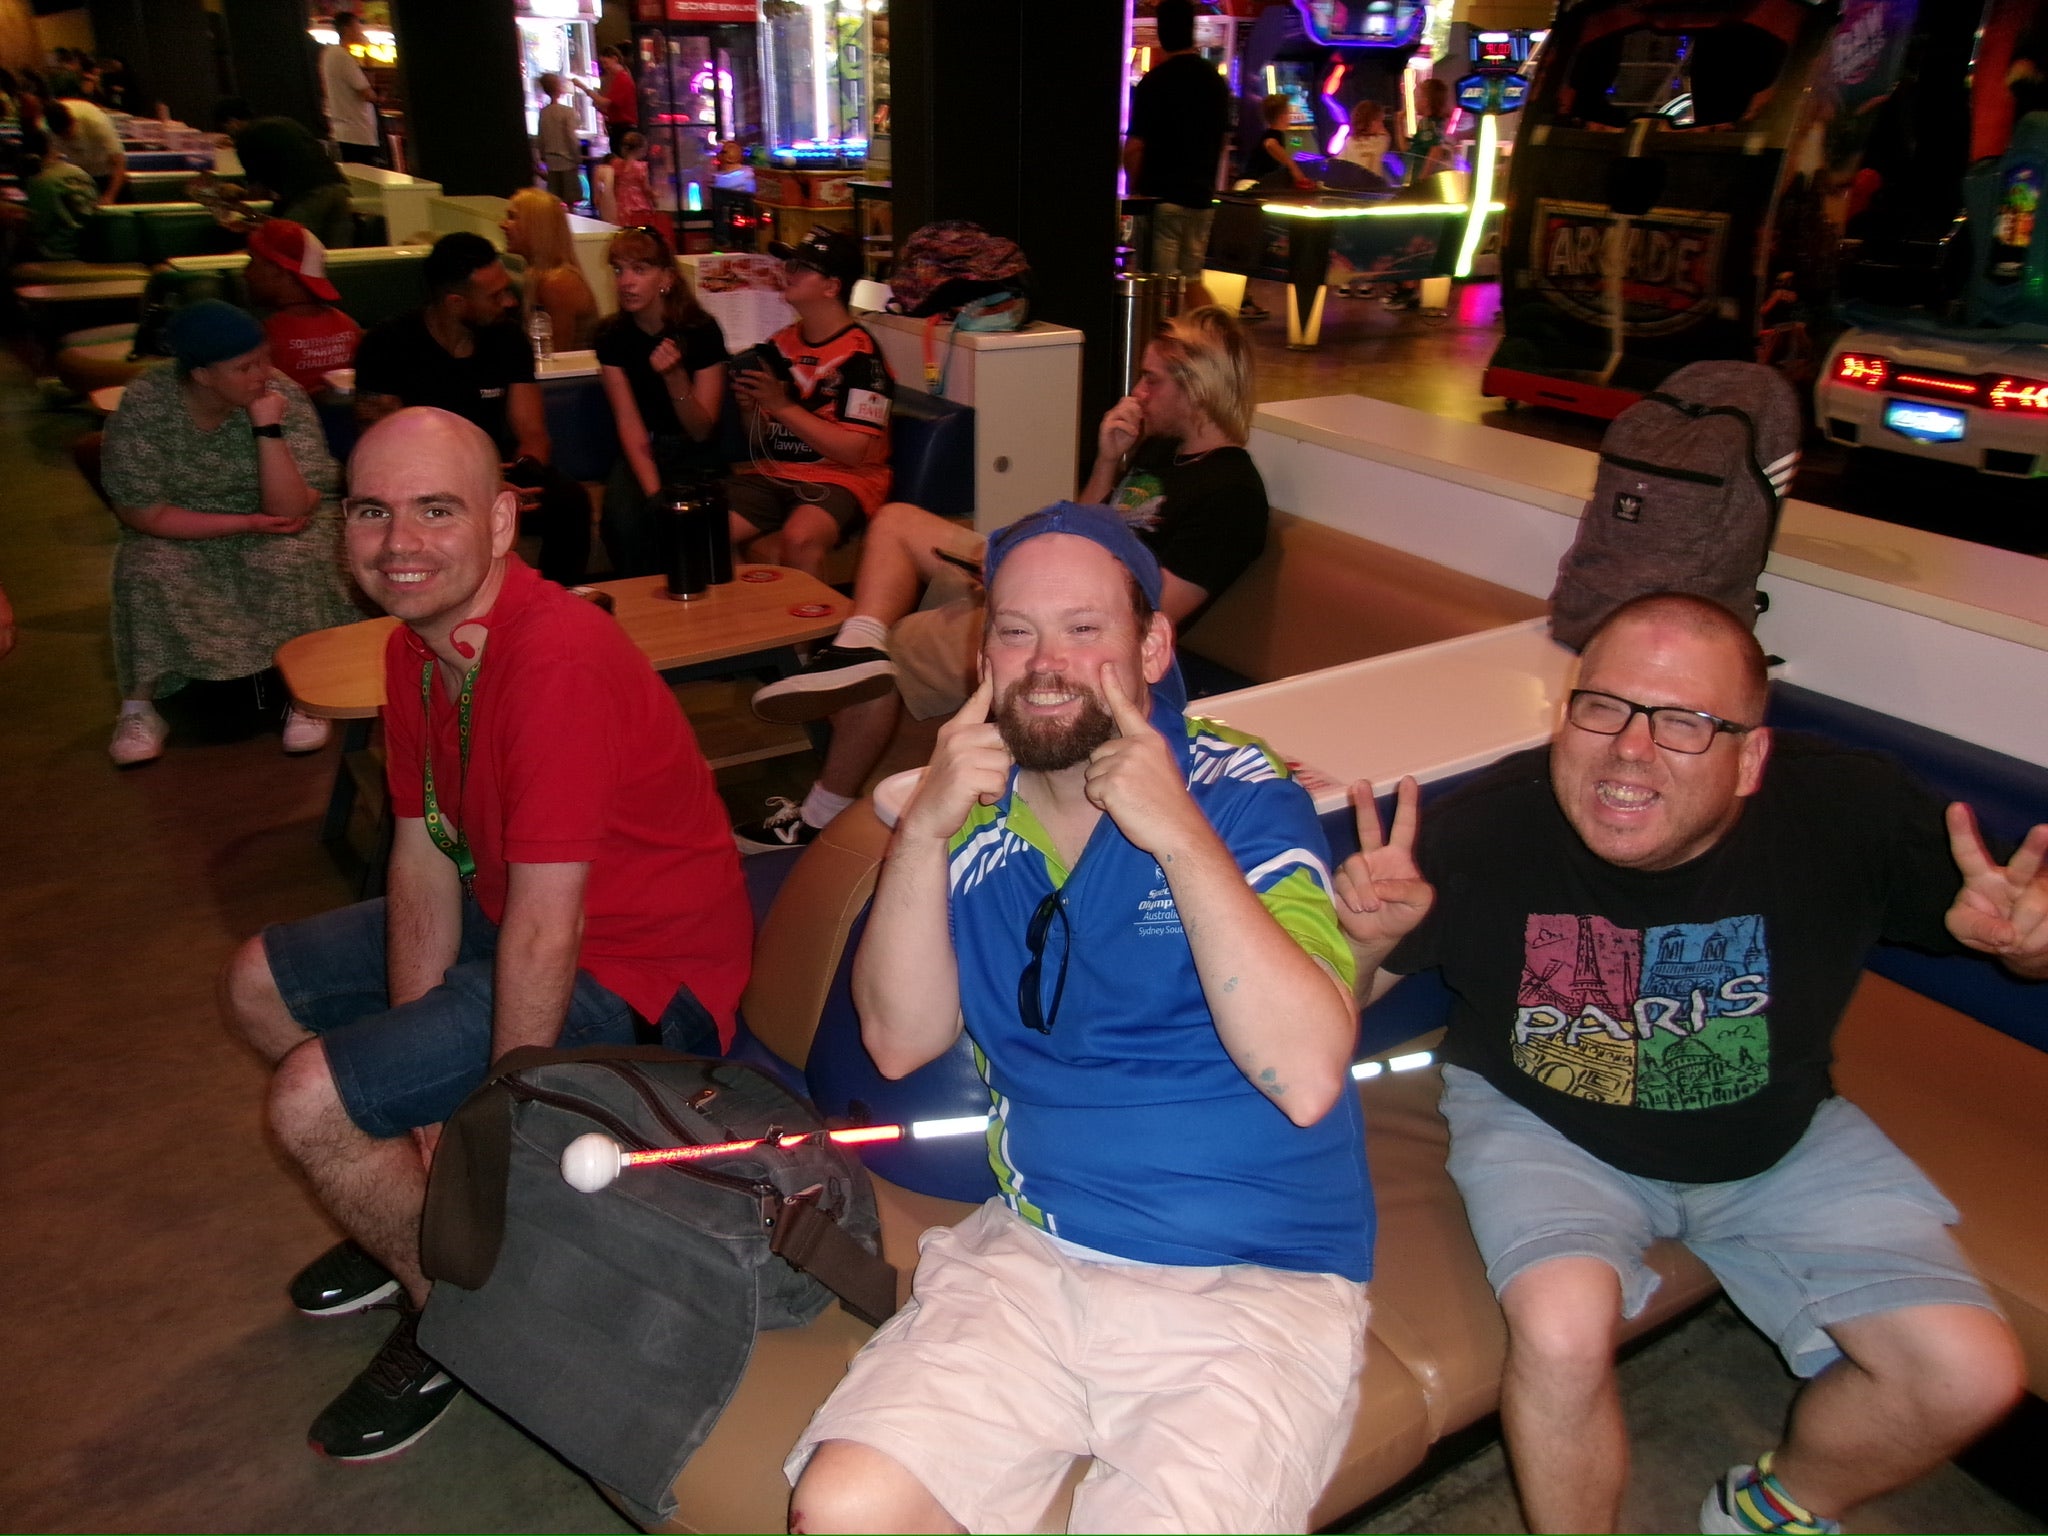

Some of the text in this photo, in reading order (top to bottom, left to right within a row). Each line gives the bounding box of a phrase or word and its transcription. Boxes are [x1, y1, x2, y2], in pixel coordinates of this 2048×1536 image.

[773, 438, 812, 454] lawye
[1148, 888, 1170, 899] Spec
[1138, 900, 1175, 910] Olymp
[1139, 926, 1184, 937] Sydney Sout
[1515, 974, 1769, 1046] PARIS
